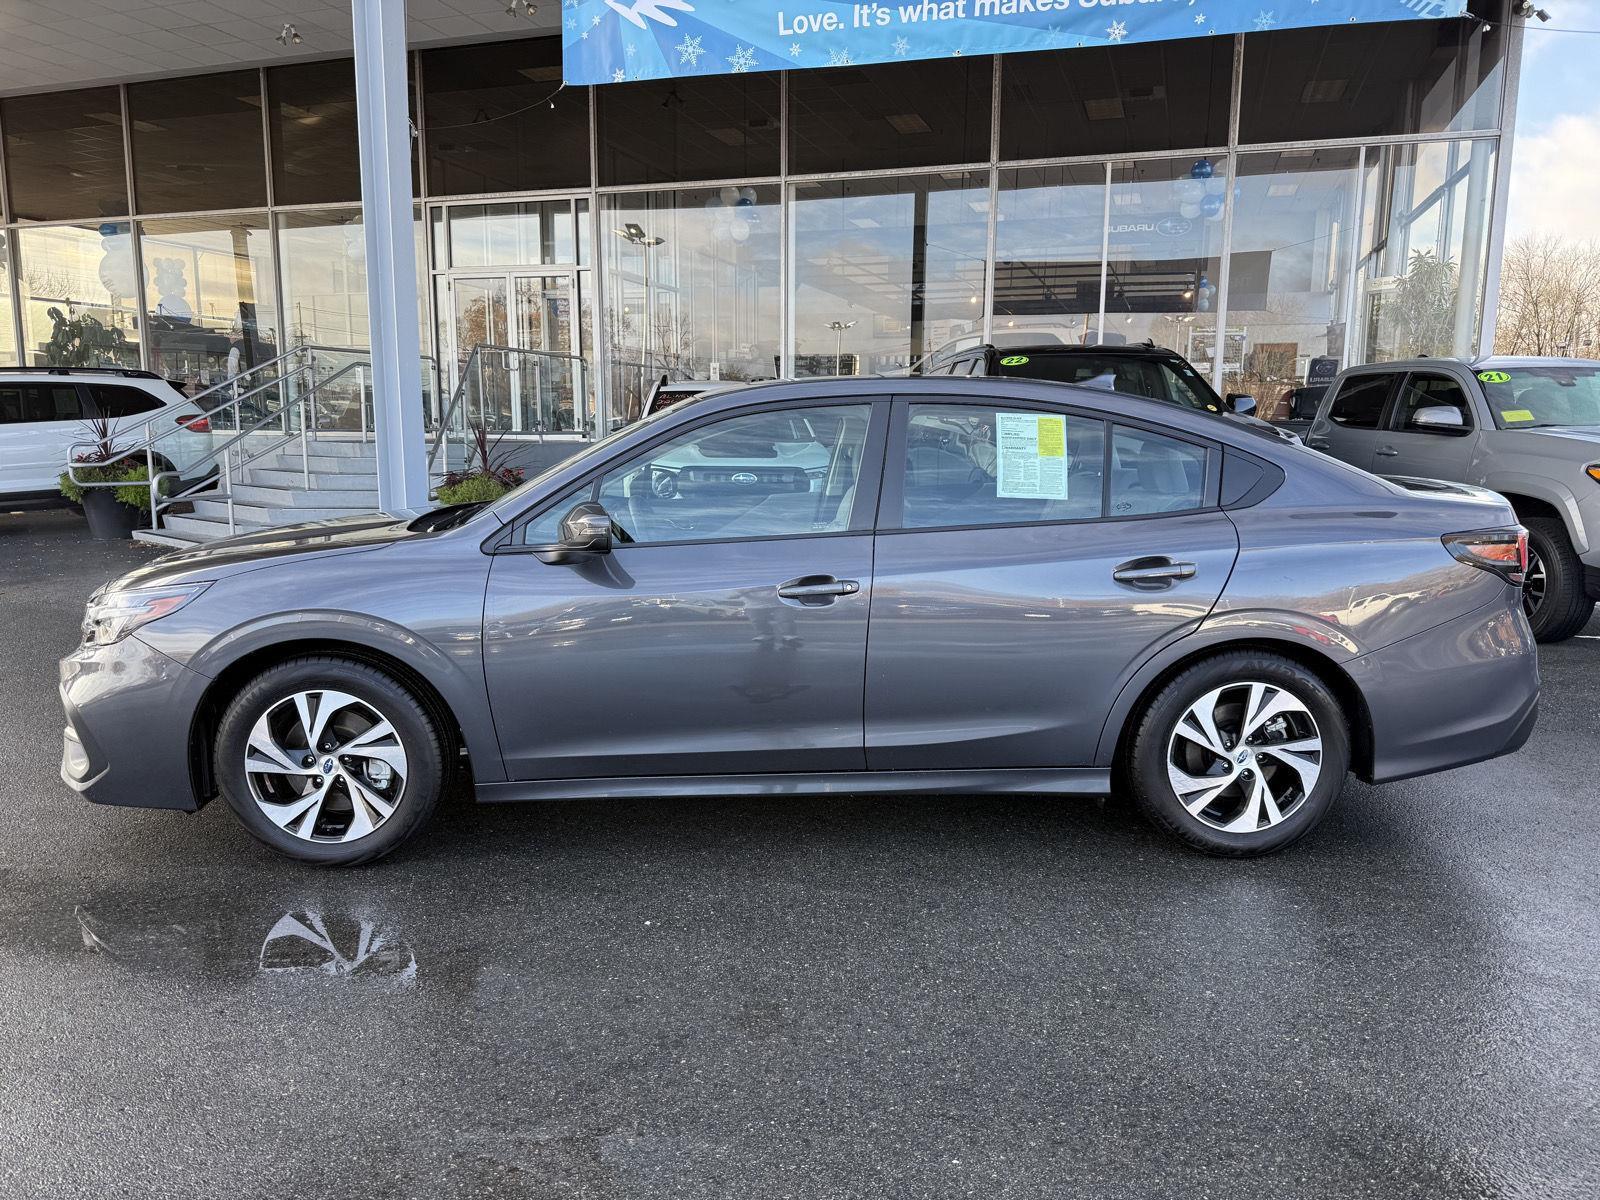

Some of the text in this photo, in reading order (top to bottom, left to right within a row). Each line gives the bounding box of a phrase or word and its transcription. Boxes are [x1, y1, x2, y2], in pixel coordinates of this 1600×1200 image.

[778, 11, 844, 36] Love.
[853, 4, 890, 28] It's
[898, 0, 966, 24] what
[1005, 357, 1024, 365] 22
[1483, 372, 1504, 382] 21
